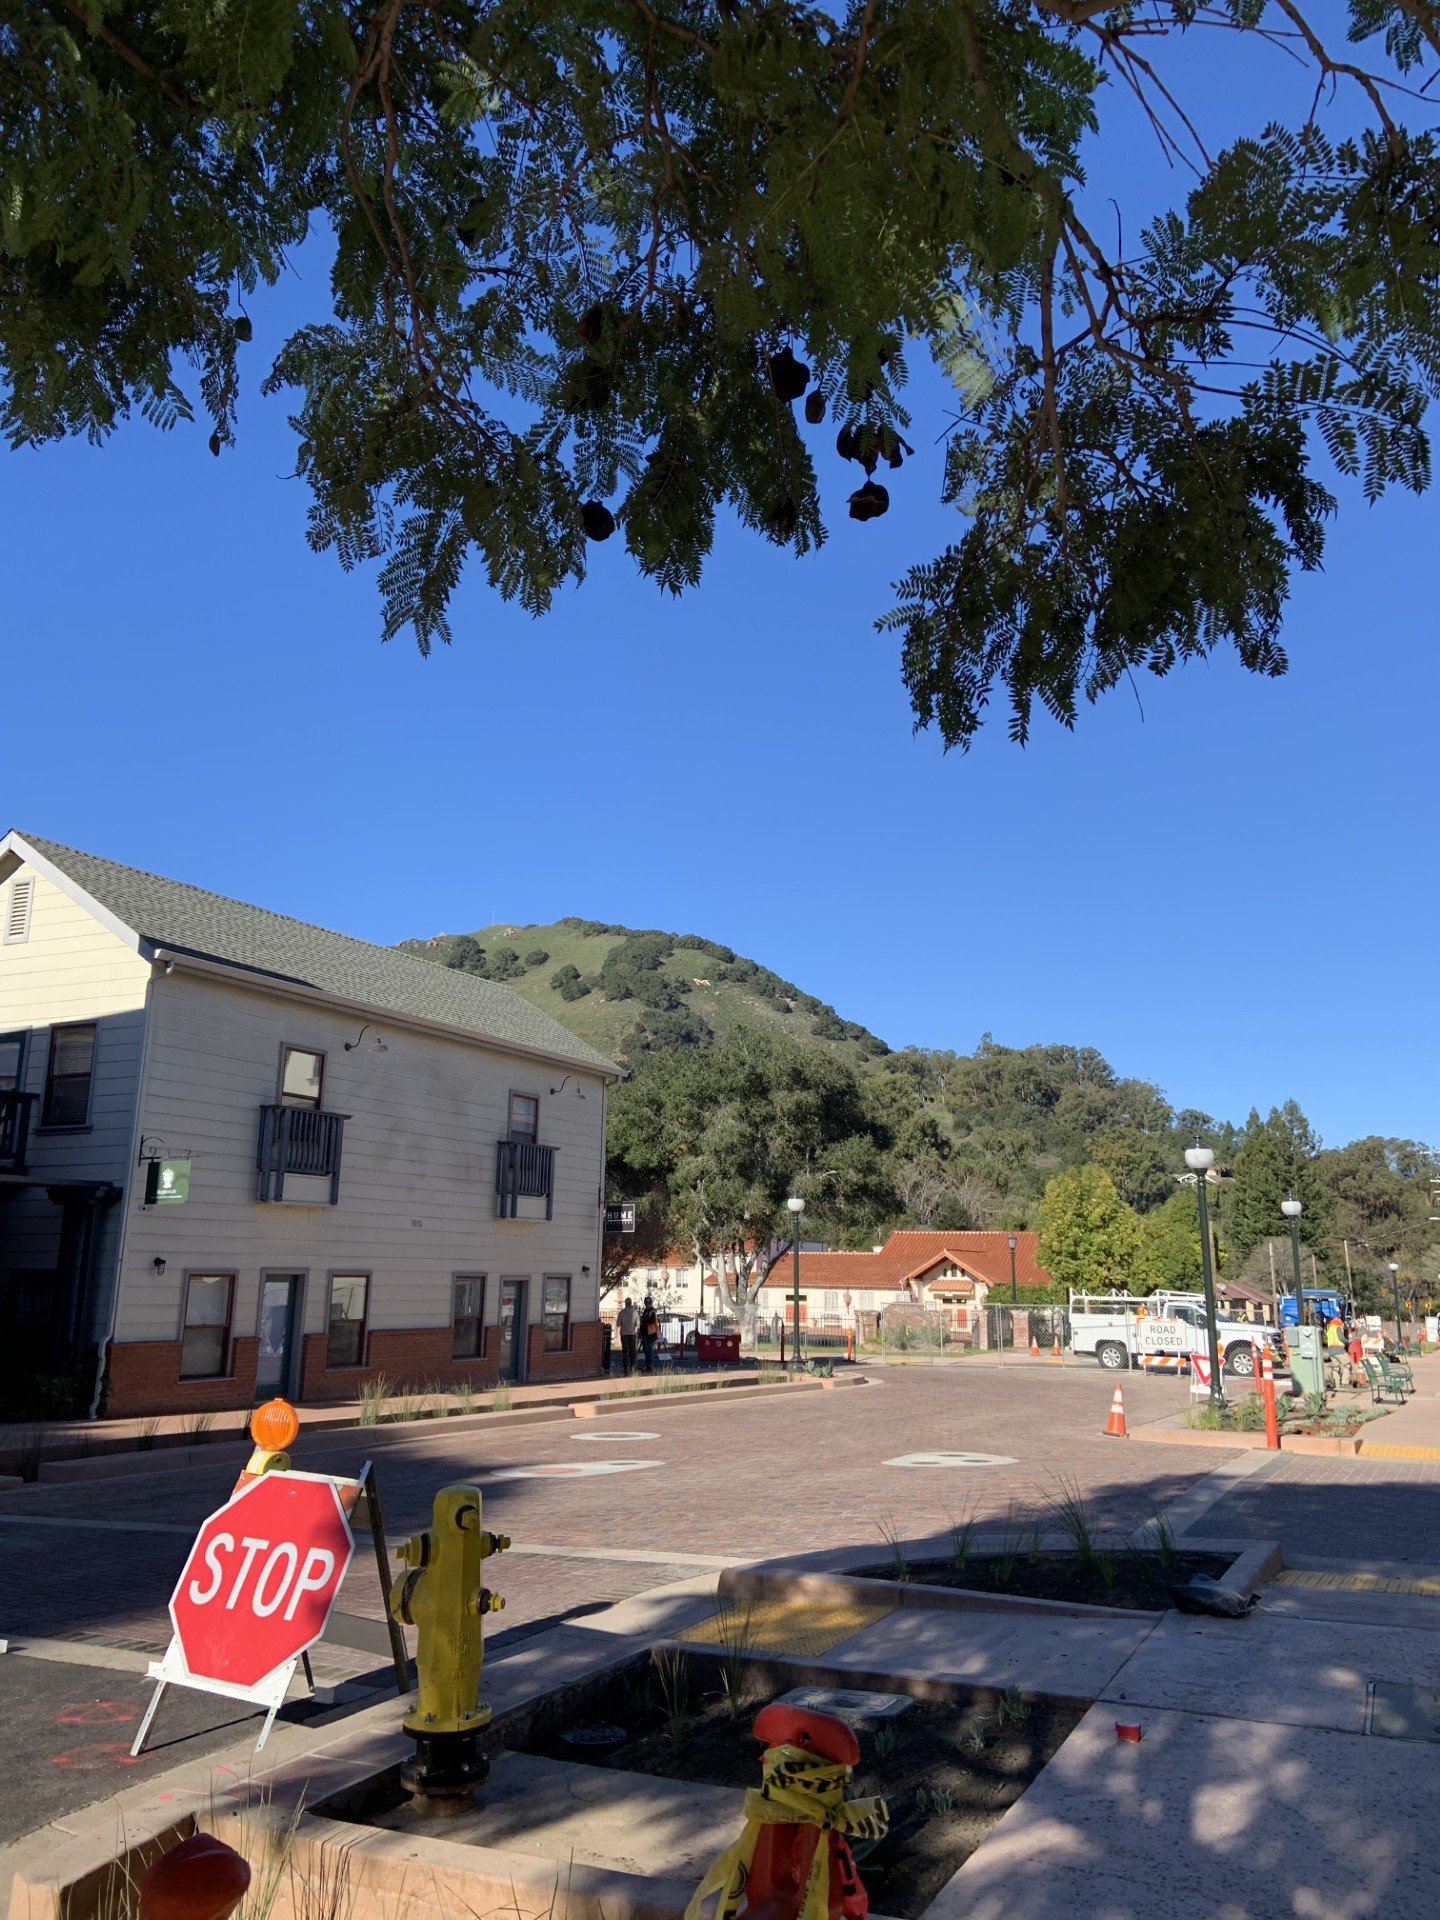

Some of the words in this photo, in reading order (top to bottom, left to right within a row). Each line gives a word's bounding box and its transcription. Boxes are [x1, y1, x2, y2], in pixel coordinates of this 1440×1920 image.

[607, 1210, 633, 1219] HUME
[1150, 1325, 1176, 1335] ROAD
[1145, 1336, 1183, 1346] CLOSED
[189, 1532, 335, 1622] STOP
